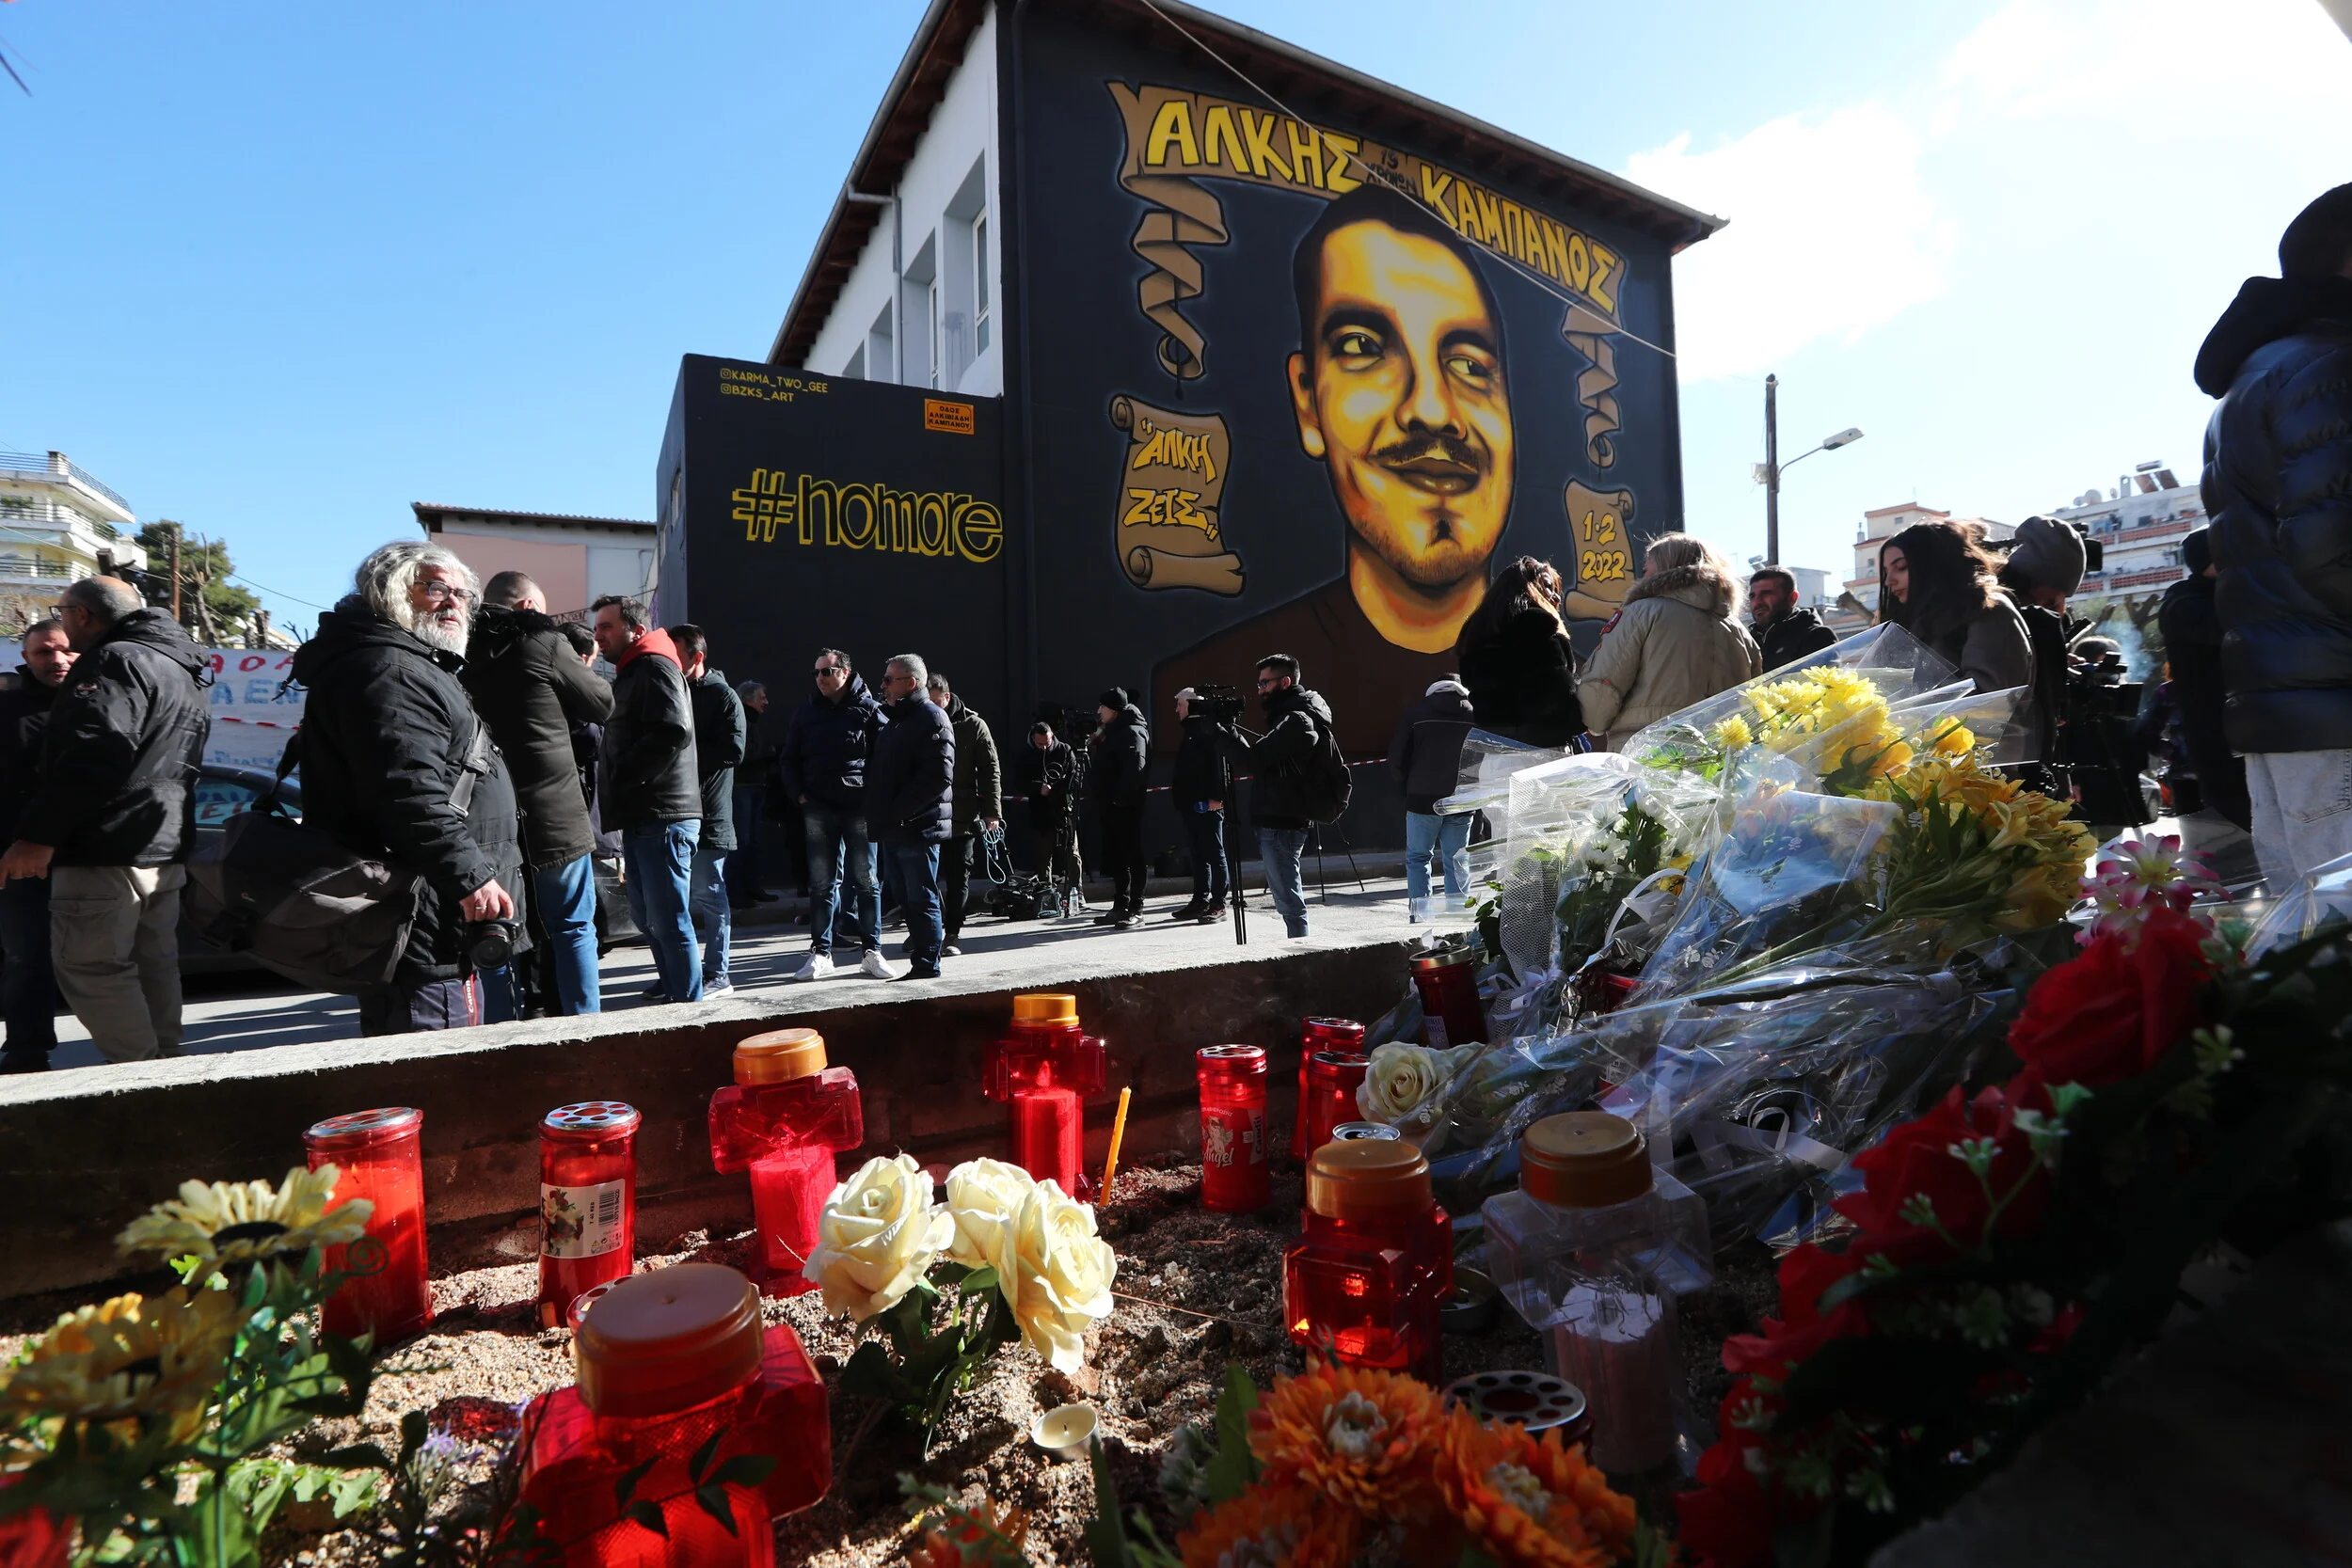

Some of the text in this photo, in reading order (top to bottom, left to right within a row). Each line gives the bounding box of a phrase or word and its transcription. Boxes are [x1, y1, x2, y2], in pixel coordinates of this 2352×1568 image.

[1144, 100, 1363, 193] ΑΛΚΗΣ
[1419, 163, 1616, 314] ΚΑΜΠΑΝΟΣ
[929, 412, 970, 422] ΑΛΚΙΒΙΑΔΗ
[929, 420, 970, 429] ΚΑΜΠΑΝΟΥ
[939, 405, 960, 414] ΟΔΟΣ
[732, 467, 1004, 563] #nomore
[1581, 549, 1627, 583] 2022
[465, 979, 474, 1013] Canon
